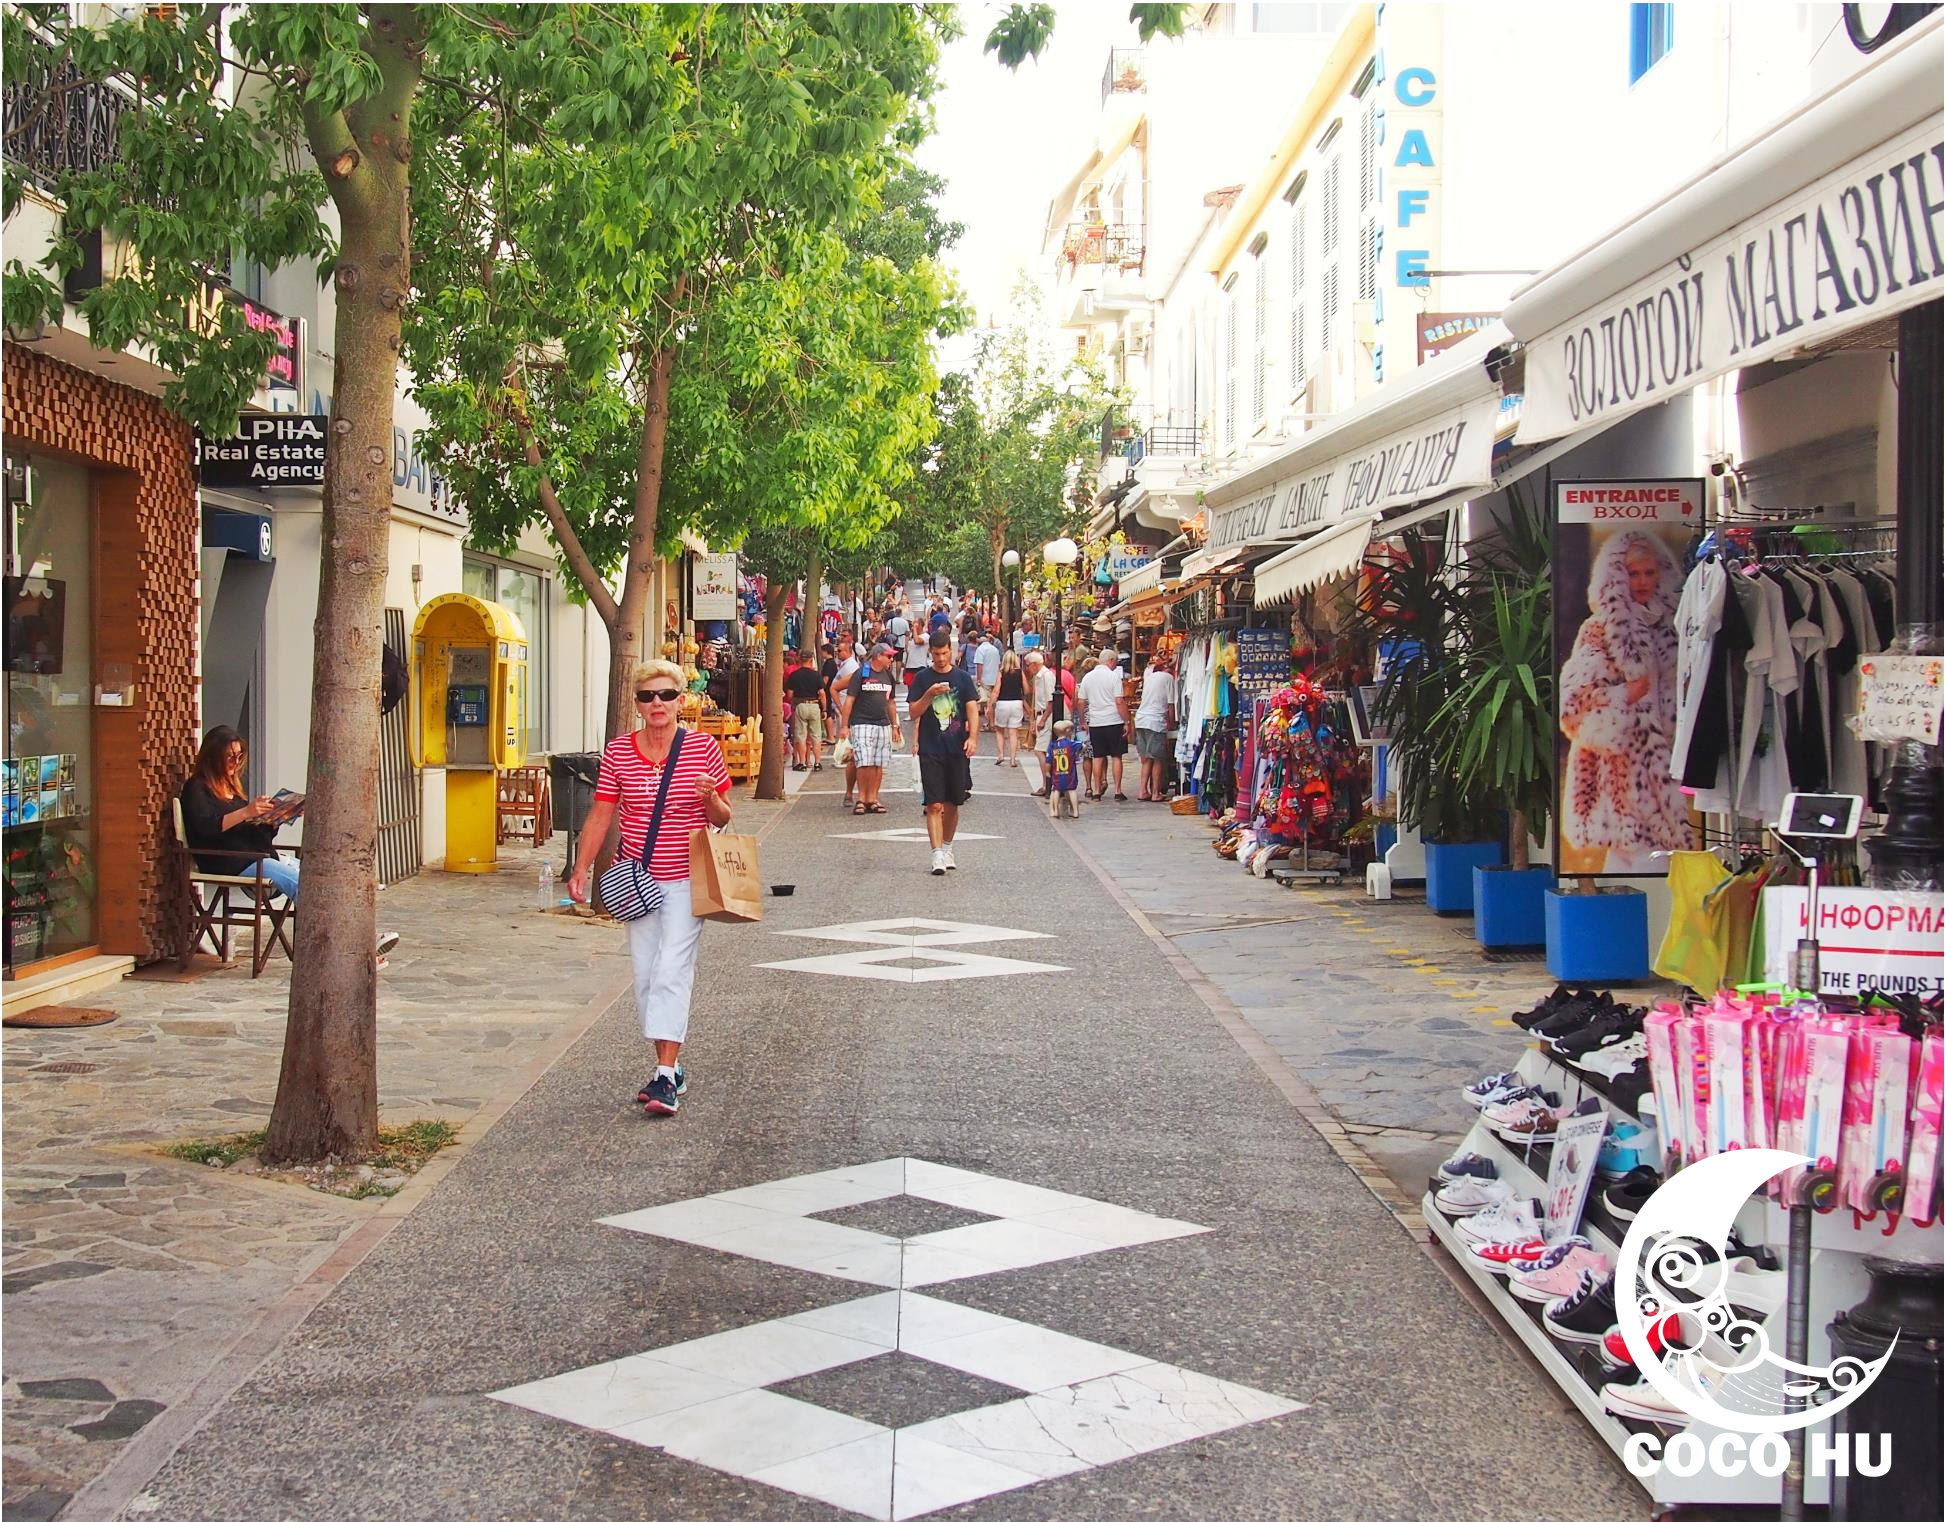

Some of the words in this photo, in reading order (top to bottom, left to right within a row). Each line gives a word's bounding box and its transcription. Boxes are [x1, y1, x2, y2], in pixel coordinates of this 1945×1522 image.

[1394, 67, 1436, 287] CAFE
[1564, 254, 1704, 421] ЗОЛОТОЙ
[1726, 141, 1944, 356] МАГАЗИН
[204, 445, 249, 461] Real
[255, 444, 324, 461] Estate
[251, 463, 324, 481] Agency
[1566, 488, 1680, 504] ENTRANCE
[1594, 505, 1658, 520] ВХОД
[694, 556, 735, 564] MELISSA
[1113, 558, 1127, 569] LA
[1053, 753, 1069, 773] 10
[1822, 971, 1851, 988] THE
[1857, 973, 1928, 992] POUNDS
